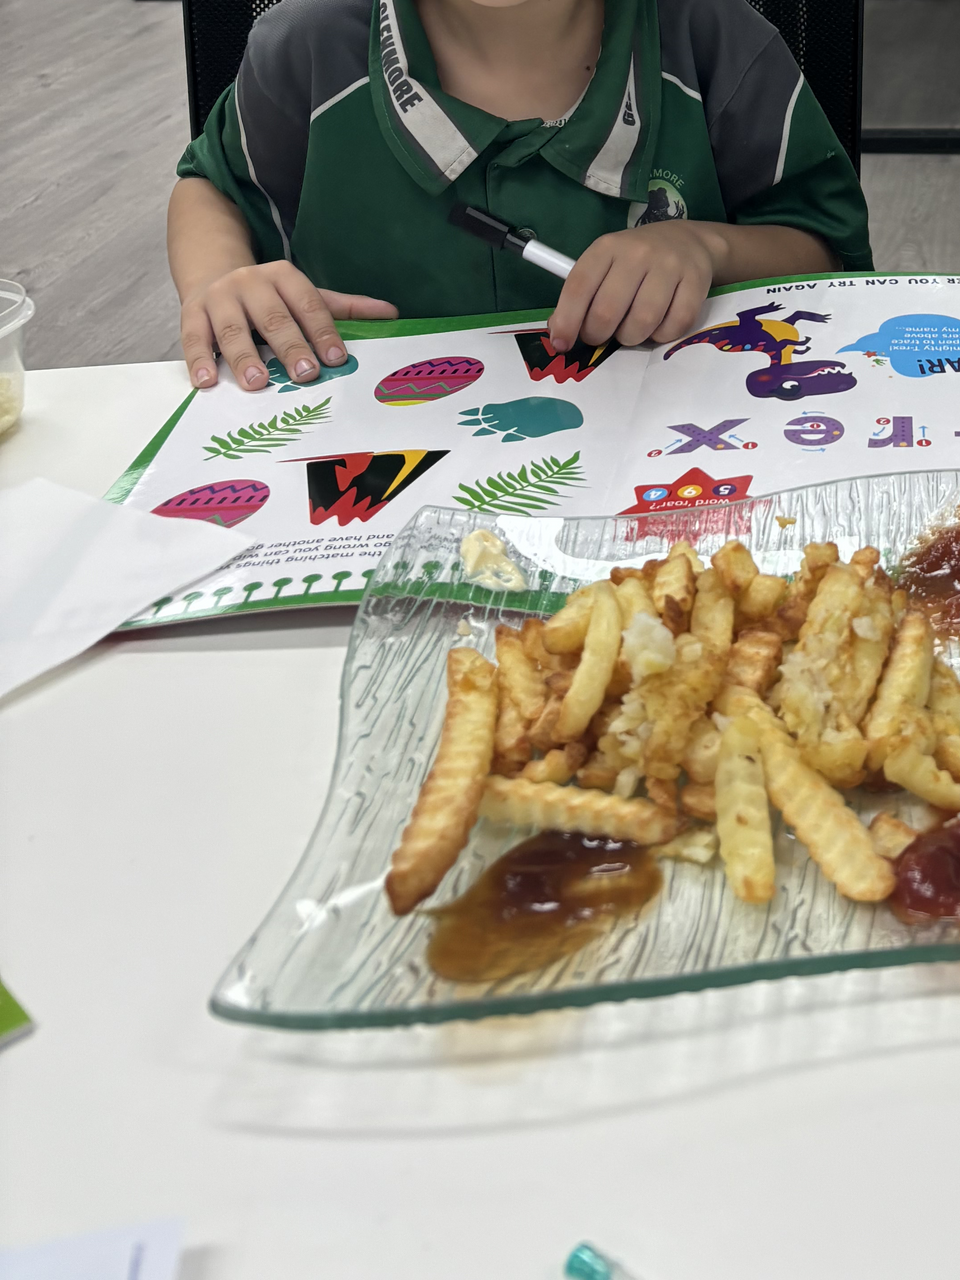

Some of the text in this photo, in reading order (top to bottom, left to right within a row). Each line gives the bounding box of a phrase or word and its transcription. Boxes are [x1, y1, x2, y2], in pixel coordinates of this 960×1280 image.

[380, 2, 424, 114] GLENMORE
[650, 168, 685, 189] MORE
[766, 283, 817, 295] AGAIN
[827, 280, 857, 288] TRY
[649, 485, 731, 499] 5 9 4
[695, 498, 730, 507] word
[328, 535, 362, 544] have
[367, 533, 395, 541] and
[266, 538, 324, 550] another
[323, 542, 369, 552] wrong
[263, 549, 290, 558] can
[293, 545, 321, 554] you
[359, 549, 383, 558] the
[284, 552, 355, 564] matching
[236, 558, 281, 569] things
